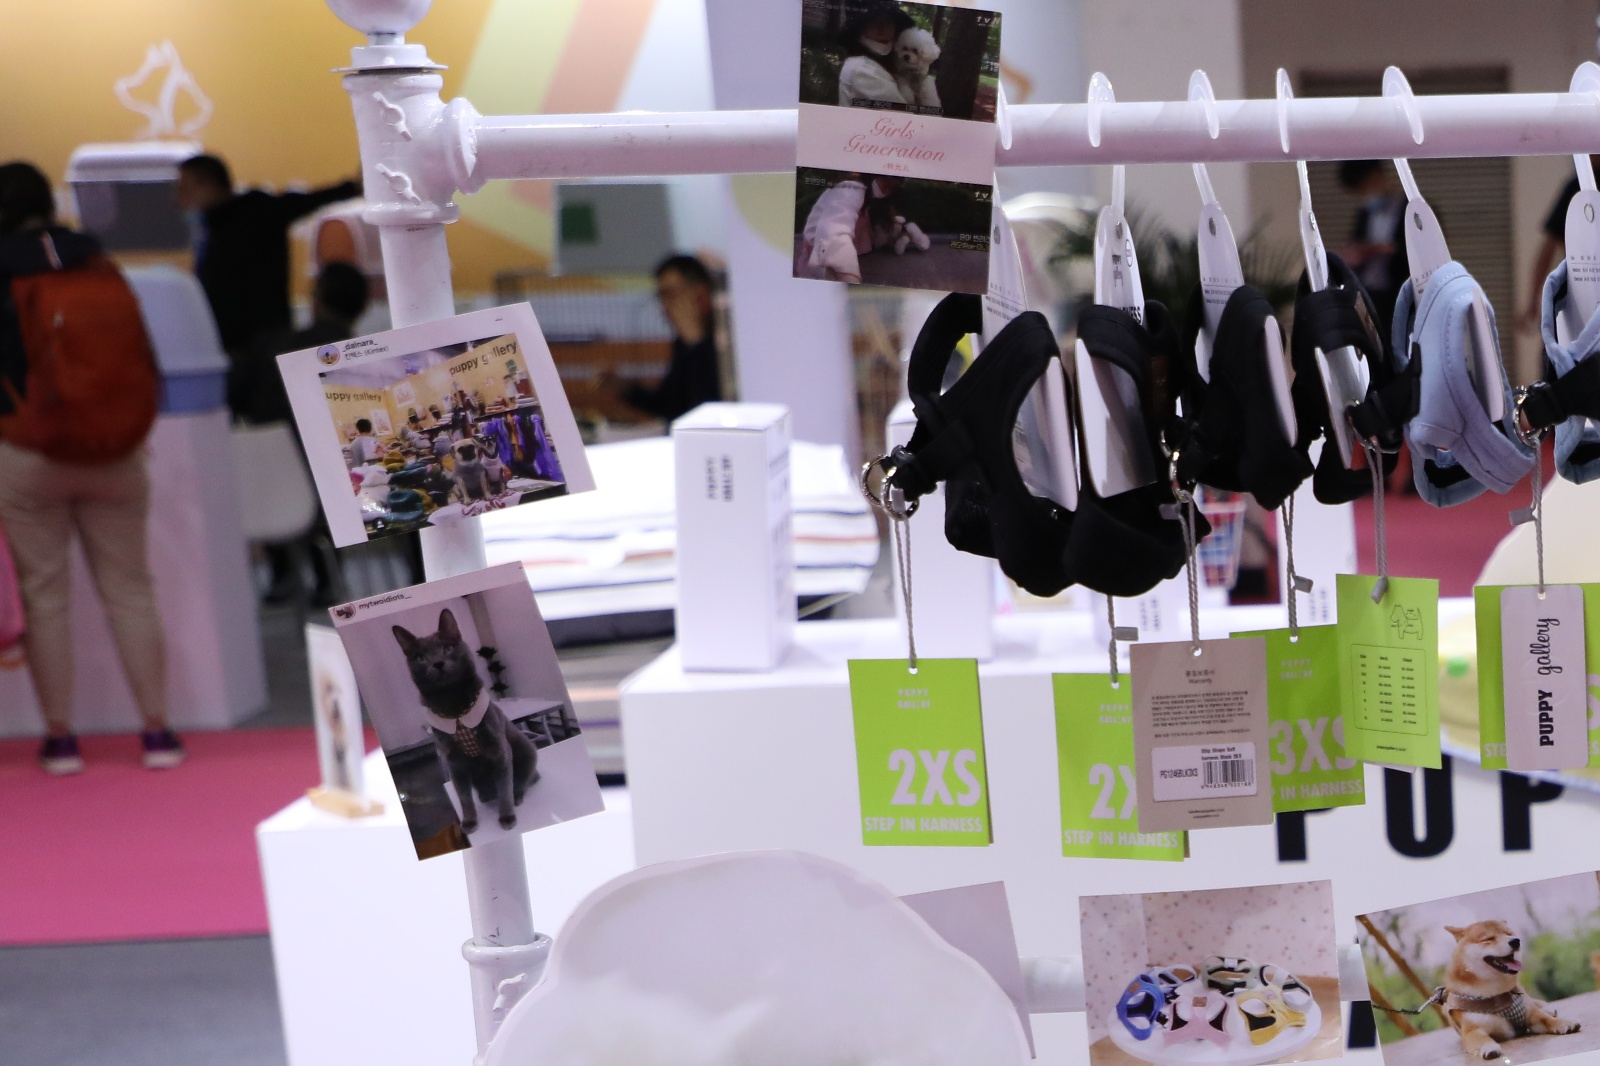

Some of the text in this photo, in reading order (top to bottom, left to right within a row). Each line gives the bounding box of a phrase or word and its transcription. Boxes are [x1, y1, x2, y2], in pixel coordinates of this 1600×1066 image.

[869, 117, 924, 139] Girls'
[843, 134, 946, 163] Generation
[450, 358, 478, 375] puppy
[352, 393, 382, 402] gallery
[1529, 617, 1563, 747] PUPPY gallery
[1484, 742, 1507, 758] STE
[888, 748, 982, 807] 2XS
[1088, 763, 1138, 820] 2X
[1280, 778, 1363, 800] IN HARNESS
[864, 817, 983, 833] STEP IN HARNESS
[1064, 829, 1179, 849] STEP IN HARNESS
